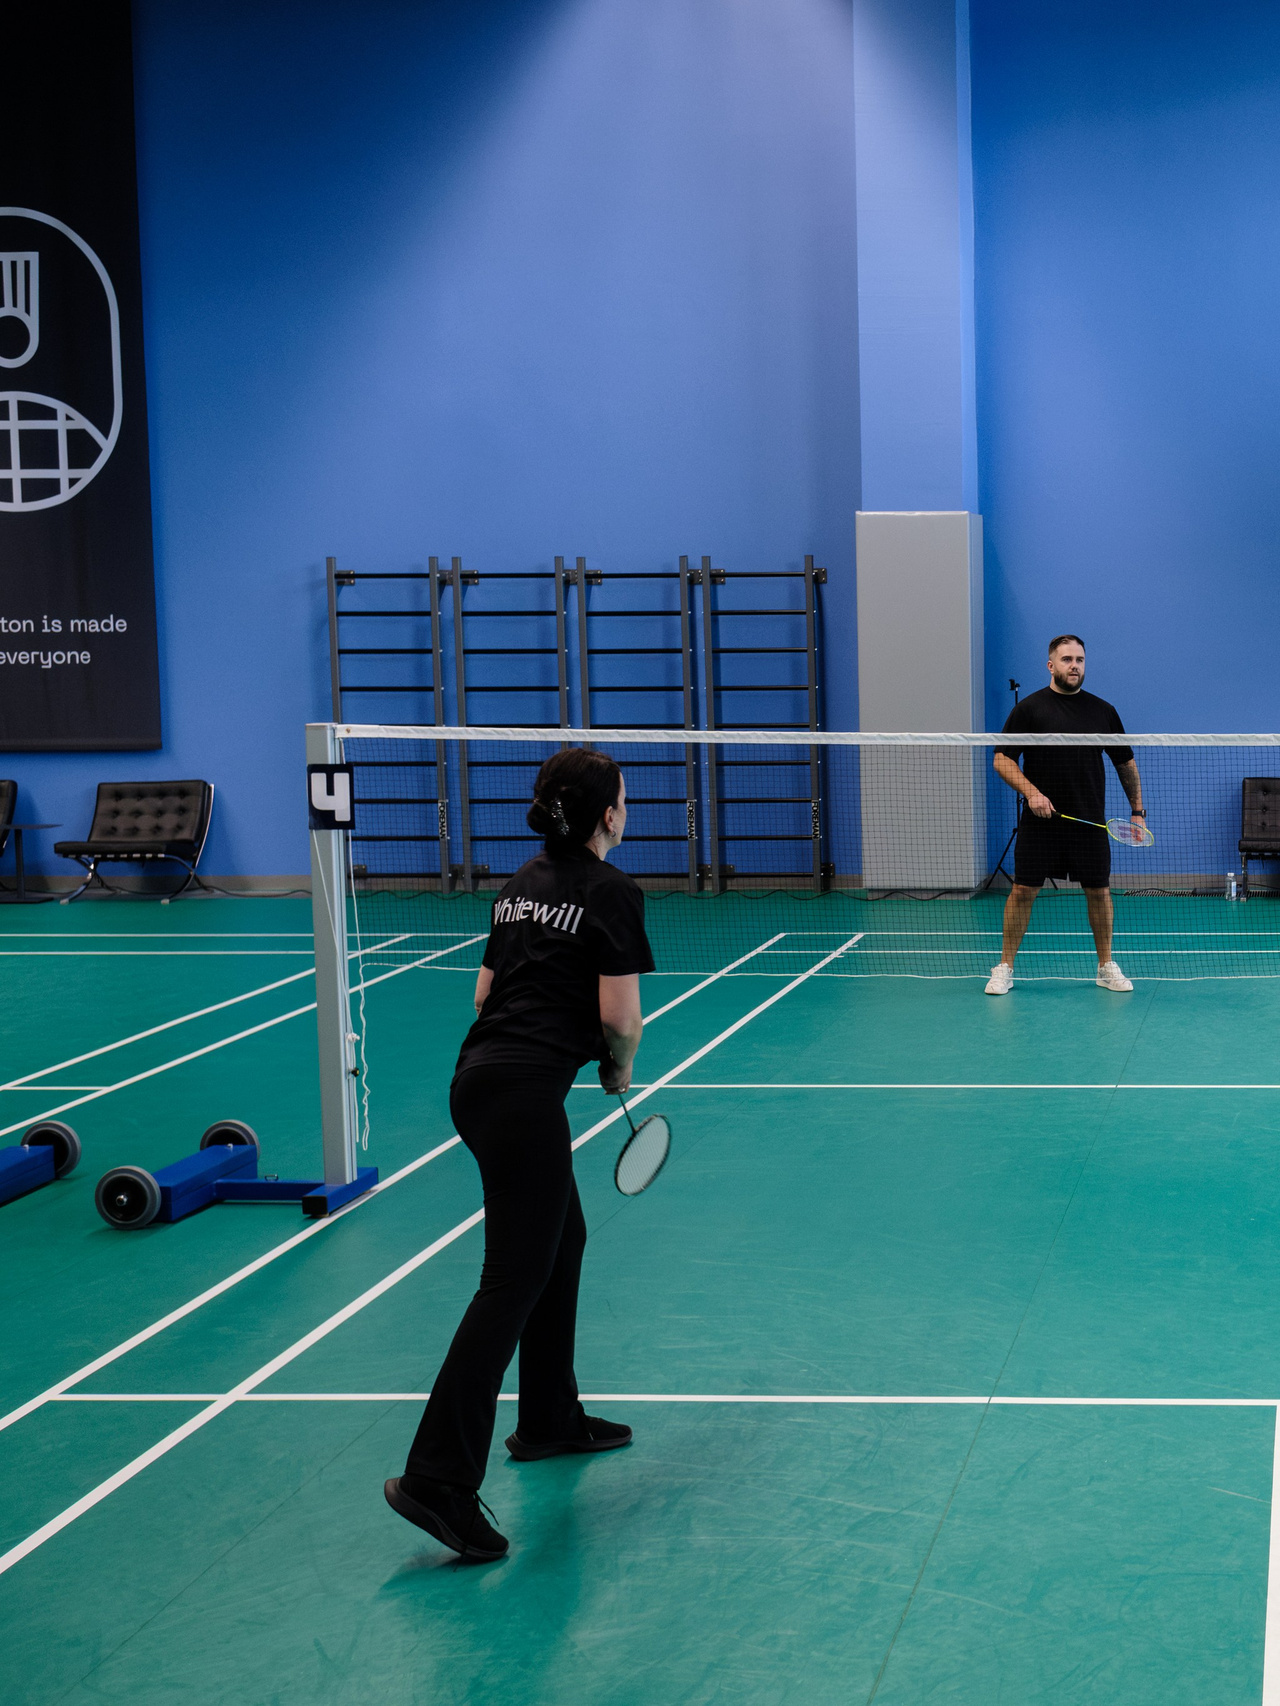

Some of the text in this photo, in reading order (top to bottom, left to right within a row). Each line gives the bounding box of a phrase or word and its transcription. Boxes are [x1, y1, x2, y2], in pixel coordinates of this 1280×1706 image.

[41, 614, 63, 633] is
[70, 614, 127, 632] made
[310, 772, 351, 822] 4
[438, 801, 447, 839] FOREMAN
[687, 801, 695, 839] FOREMAN
[811, 801, 819, 839] FOREMAN
[494, 896, 584, 934] Whitewill
